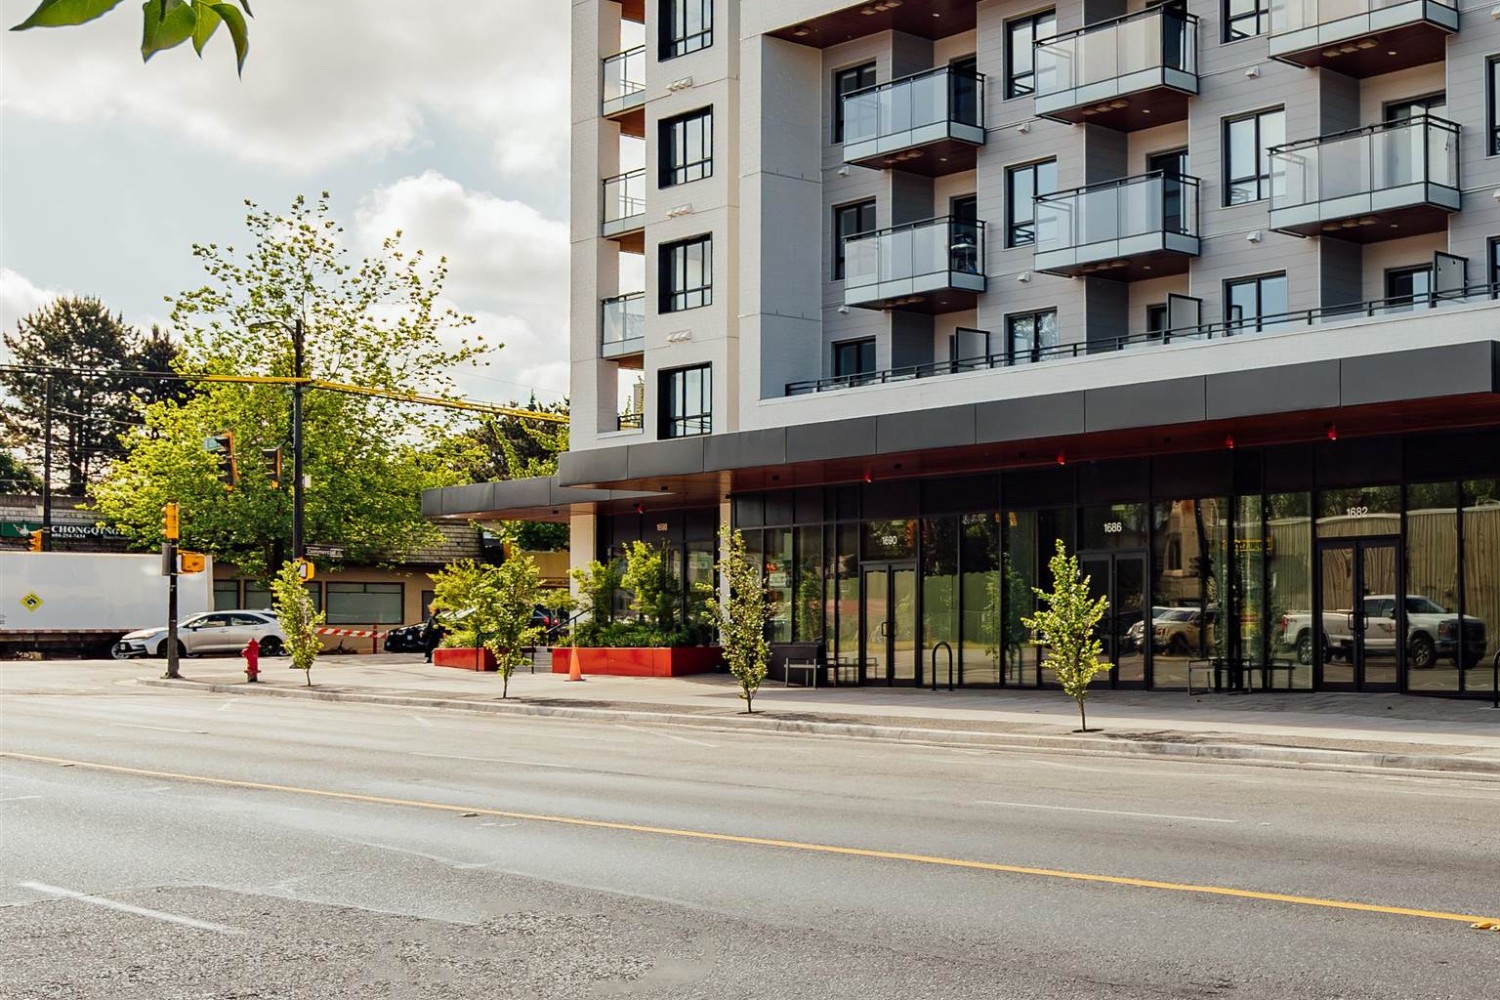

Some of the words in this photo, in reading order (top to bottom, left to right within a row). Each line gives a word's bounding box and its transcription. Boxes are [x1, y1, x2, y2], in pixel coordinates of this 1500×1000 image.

[1346, 506, 1368, 518] 1682
[51, 525, 119, 536] CHONGQING
[1104, 522, 1122, 533] 1686
[882, 535, 898, 545] 1690
